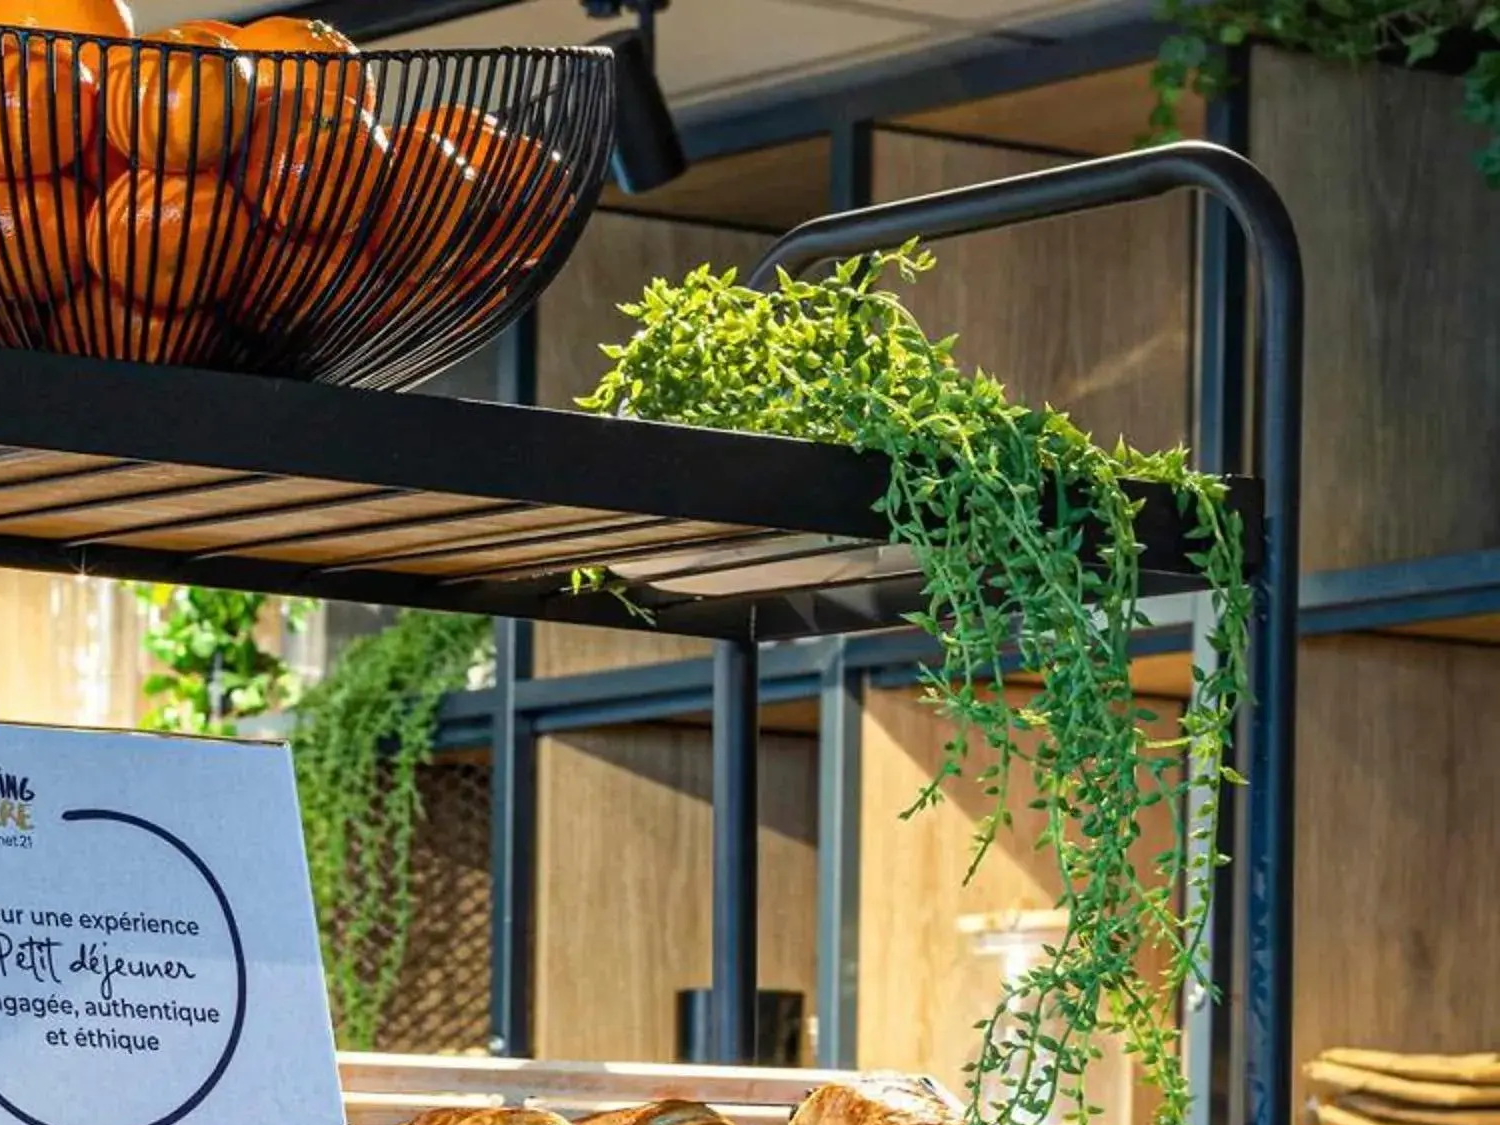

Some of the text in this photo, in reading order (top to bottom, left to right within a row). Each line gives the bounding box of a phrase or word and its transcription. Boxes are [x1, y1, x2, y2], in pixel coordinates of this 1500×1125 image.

[31, 910, 73, 927] une
[79, 912, 200, 935] expérience
[69, 941, 196, 1000] déjeuner
[85, 998, 220, 1026] authentique
[46, 1027, 160, 1053] et éthique
